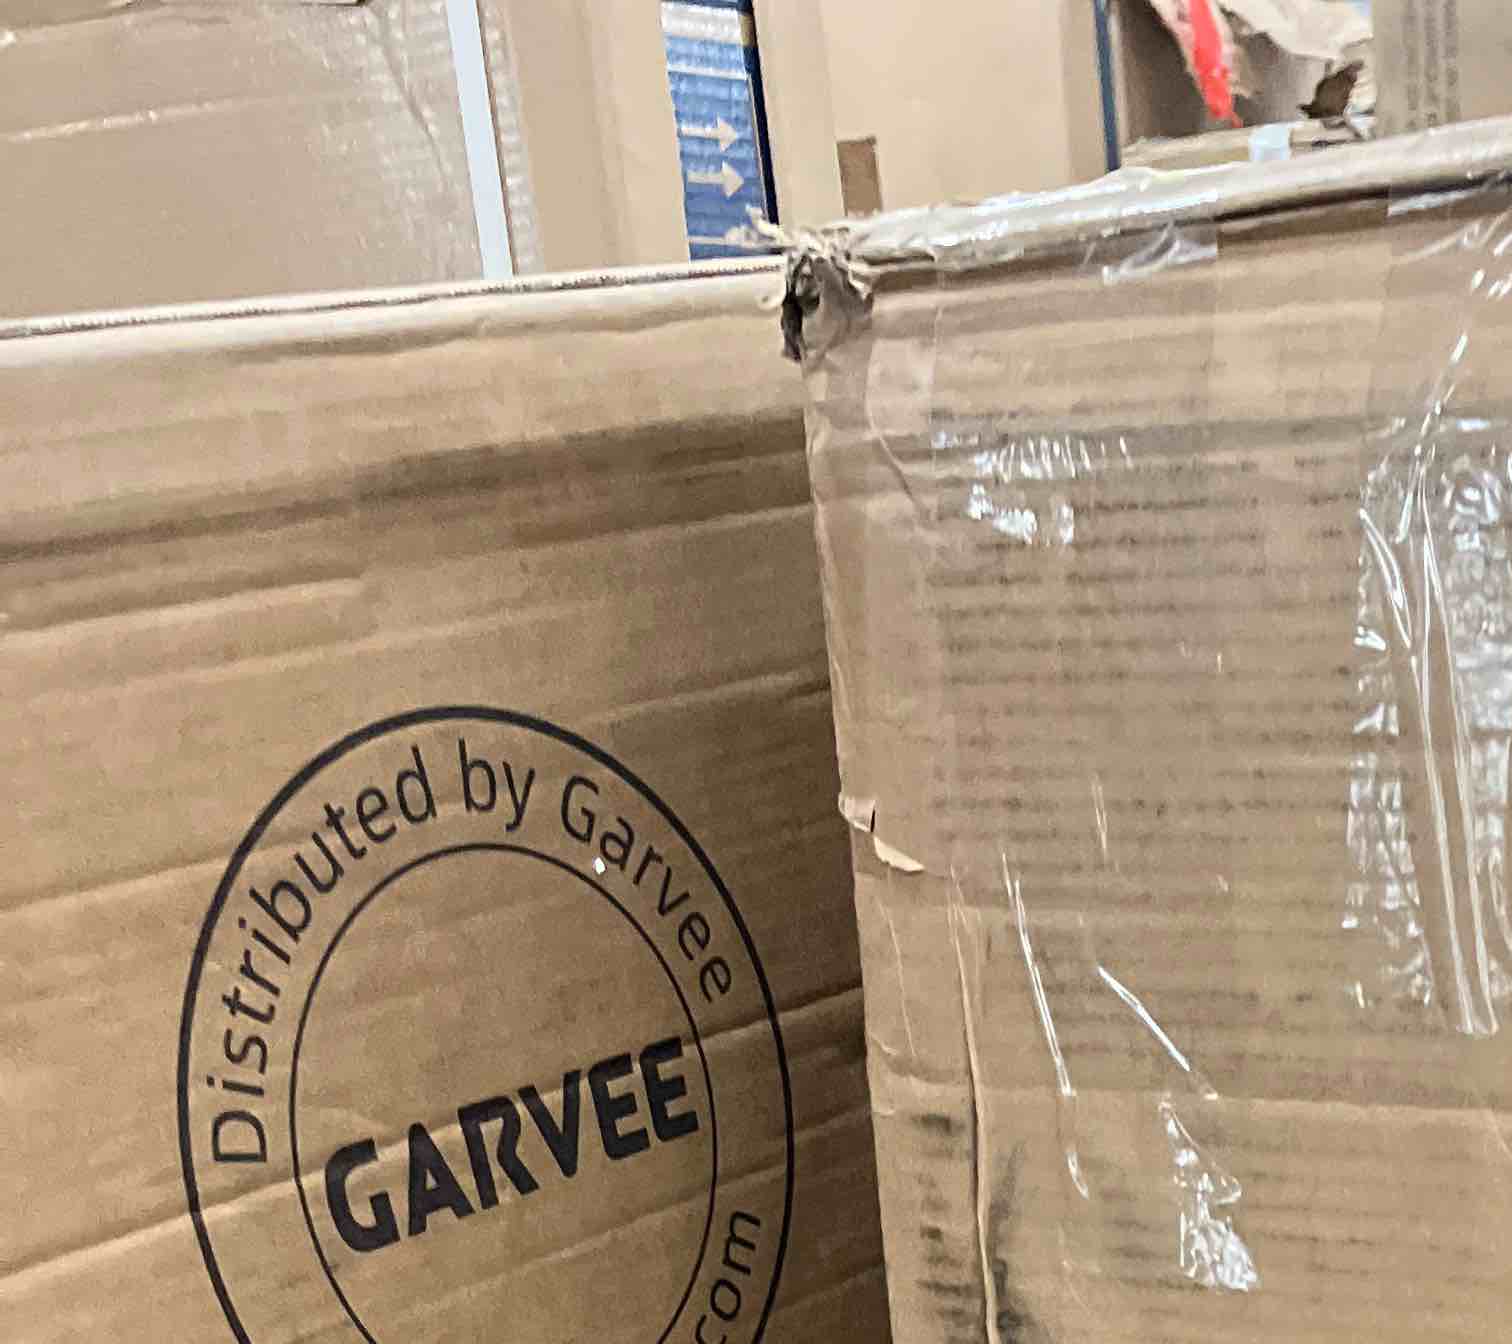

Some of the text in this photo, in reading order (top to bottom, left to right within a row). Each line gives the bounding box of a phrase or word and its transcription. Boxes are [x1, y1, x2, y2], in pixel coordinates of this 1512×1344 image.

[206, 739, 735, 1164] Distributed by Garvee
[324, 1036, 699, 1254] GARVEE
